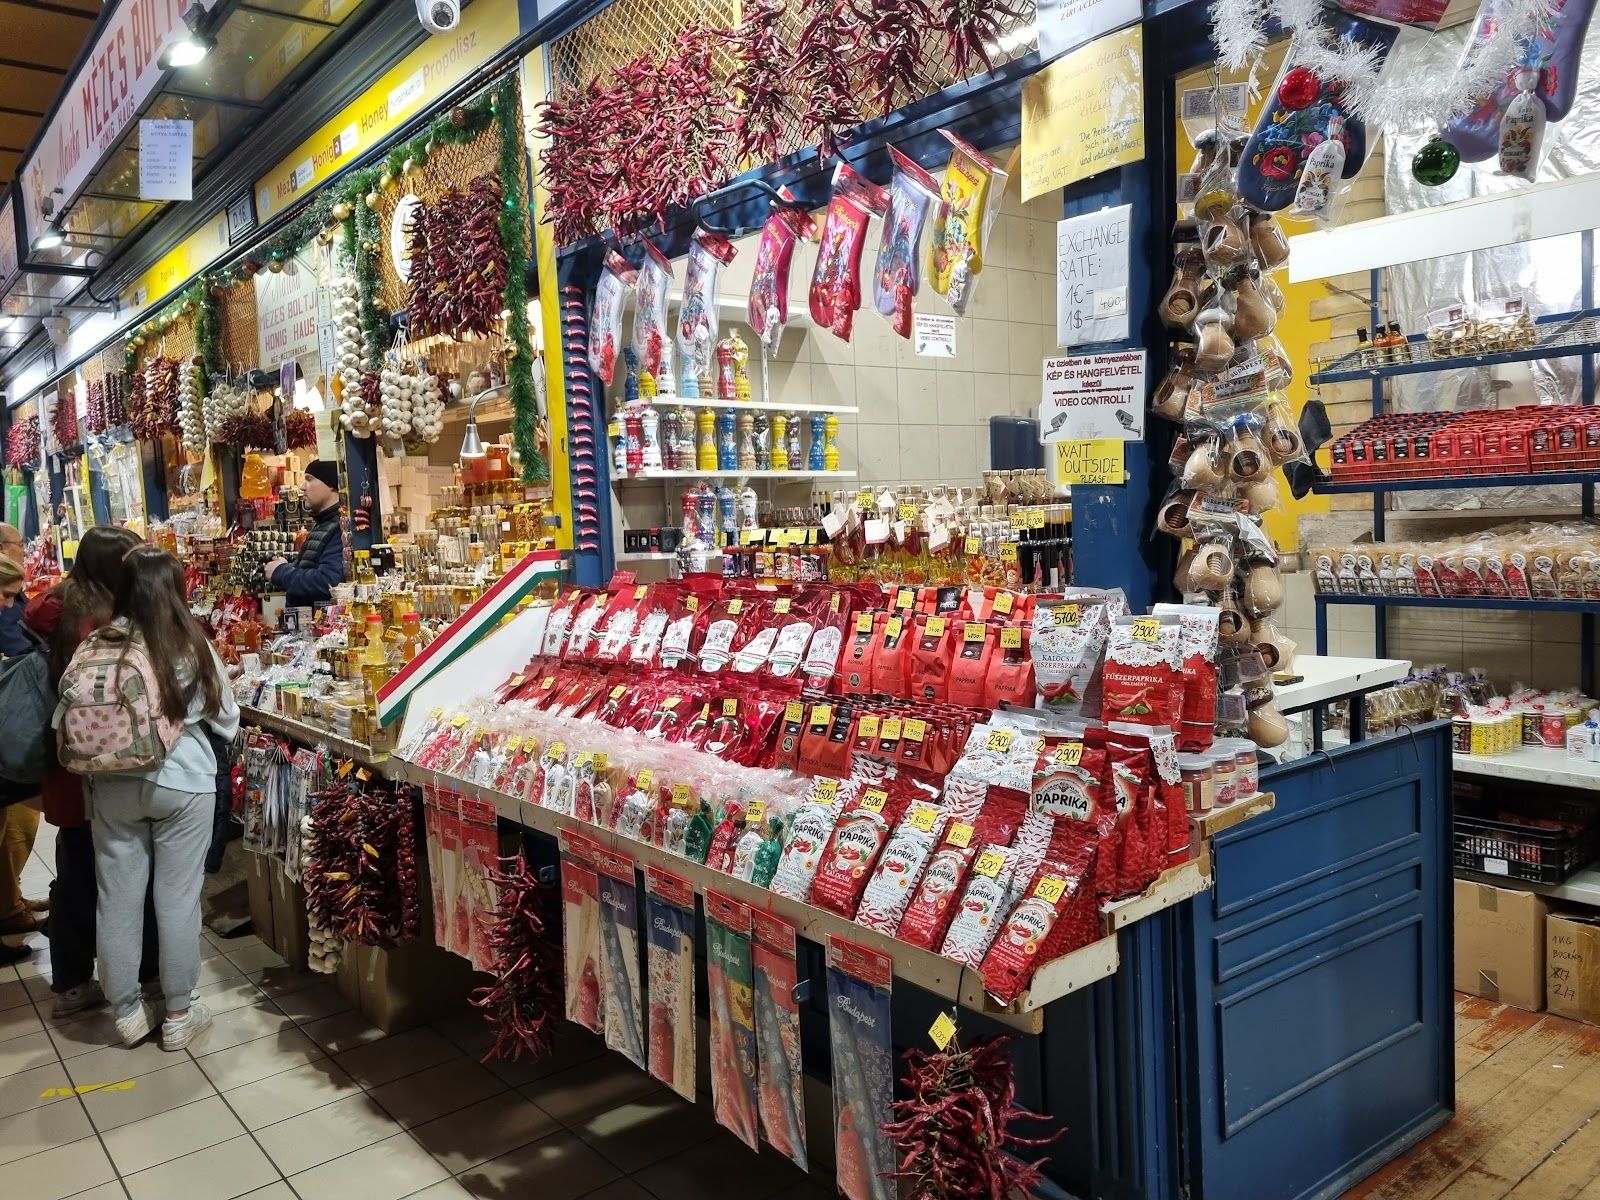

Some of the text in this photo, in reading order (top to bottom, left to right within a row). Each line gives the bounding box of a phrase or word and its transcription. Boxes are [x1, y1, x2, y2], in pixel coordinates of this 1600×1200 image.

[82, 25, 128, 149] MÉZES
[312, 145, 334, 172] Honig
[361, 99, 389, 133] Honey
[423, 31, 477, 86] Propolisz
[117, 94, 136, 127] HAUS
[1309, 157, 1336, 169] Paprika
[834, 204, 859, 229] Budapest
[1060, 220, 1126, 256] EXCHANGE
[1059, 253, 1102, 281] RATE:
[265, 316, 315, 353] HONIG HAUS
[1046, 353, 1142, 368] Az üzletben és környezetében
[1046, 365, 1142, 381] KÉP ÉS HANGFELVÉTEL
[1082, 379, 1102, 388] készül
[1055, 398, 1079, 407] VIDEO
[1081, 394, 1126, 406] CONTROLL
[1058, 443, 1092, 459] WAIT
[1064, 458, 1119, 474] OUTSIDE
[1041, 654, 1078, 663] KALOCSAI
[955, 676, 977, 685] PAPRIKA
[1105, 673, 1164, 684] FŰSZERPAPRIKA
[994, 684, 1017, 693] PAPRIKA
[1036, 792, 1088, 812] PAPRIKA
[793, 823, 824, 843] PAPRIKA
[839, 830, 876, 851] PAPRIKA
[886, 848, 918, 865] PAPRIKA
[825, 868, 852, 883] KALOCSAI
[927, 868, 956, 885] PAPRIKA
[875, 881, 897, 893] KALOCSAI
[602, 891, 627, 912] Budapest
[966, 888, 995, 903] PAPRIKA
[914, 903, 936, 915] KALOCSAI
[654, 917, 683, 939] Budape
[956, 919, 979, 931] KALOCSAI
[1014, 911, 1046, 932] PAPRIKA
[712, 942, 740, 967] Budapest
[1000, 940, 1025, 956] KALOCSAI
[836, 995, 876, 1028] Budapest
